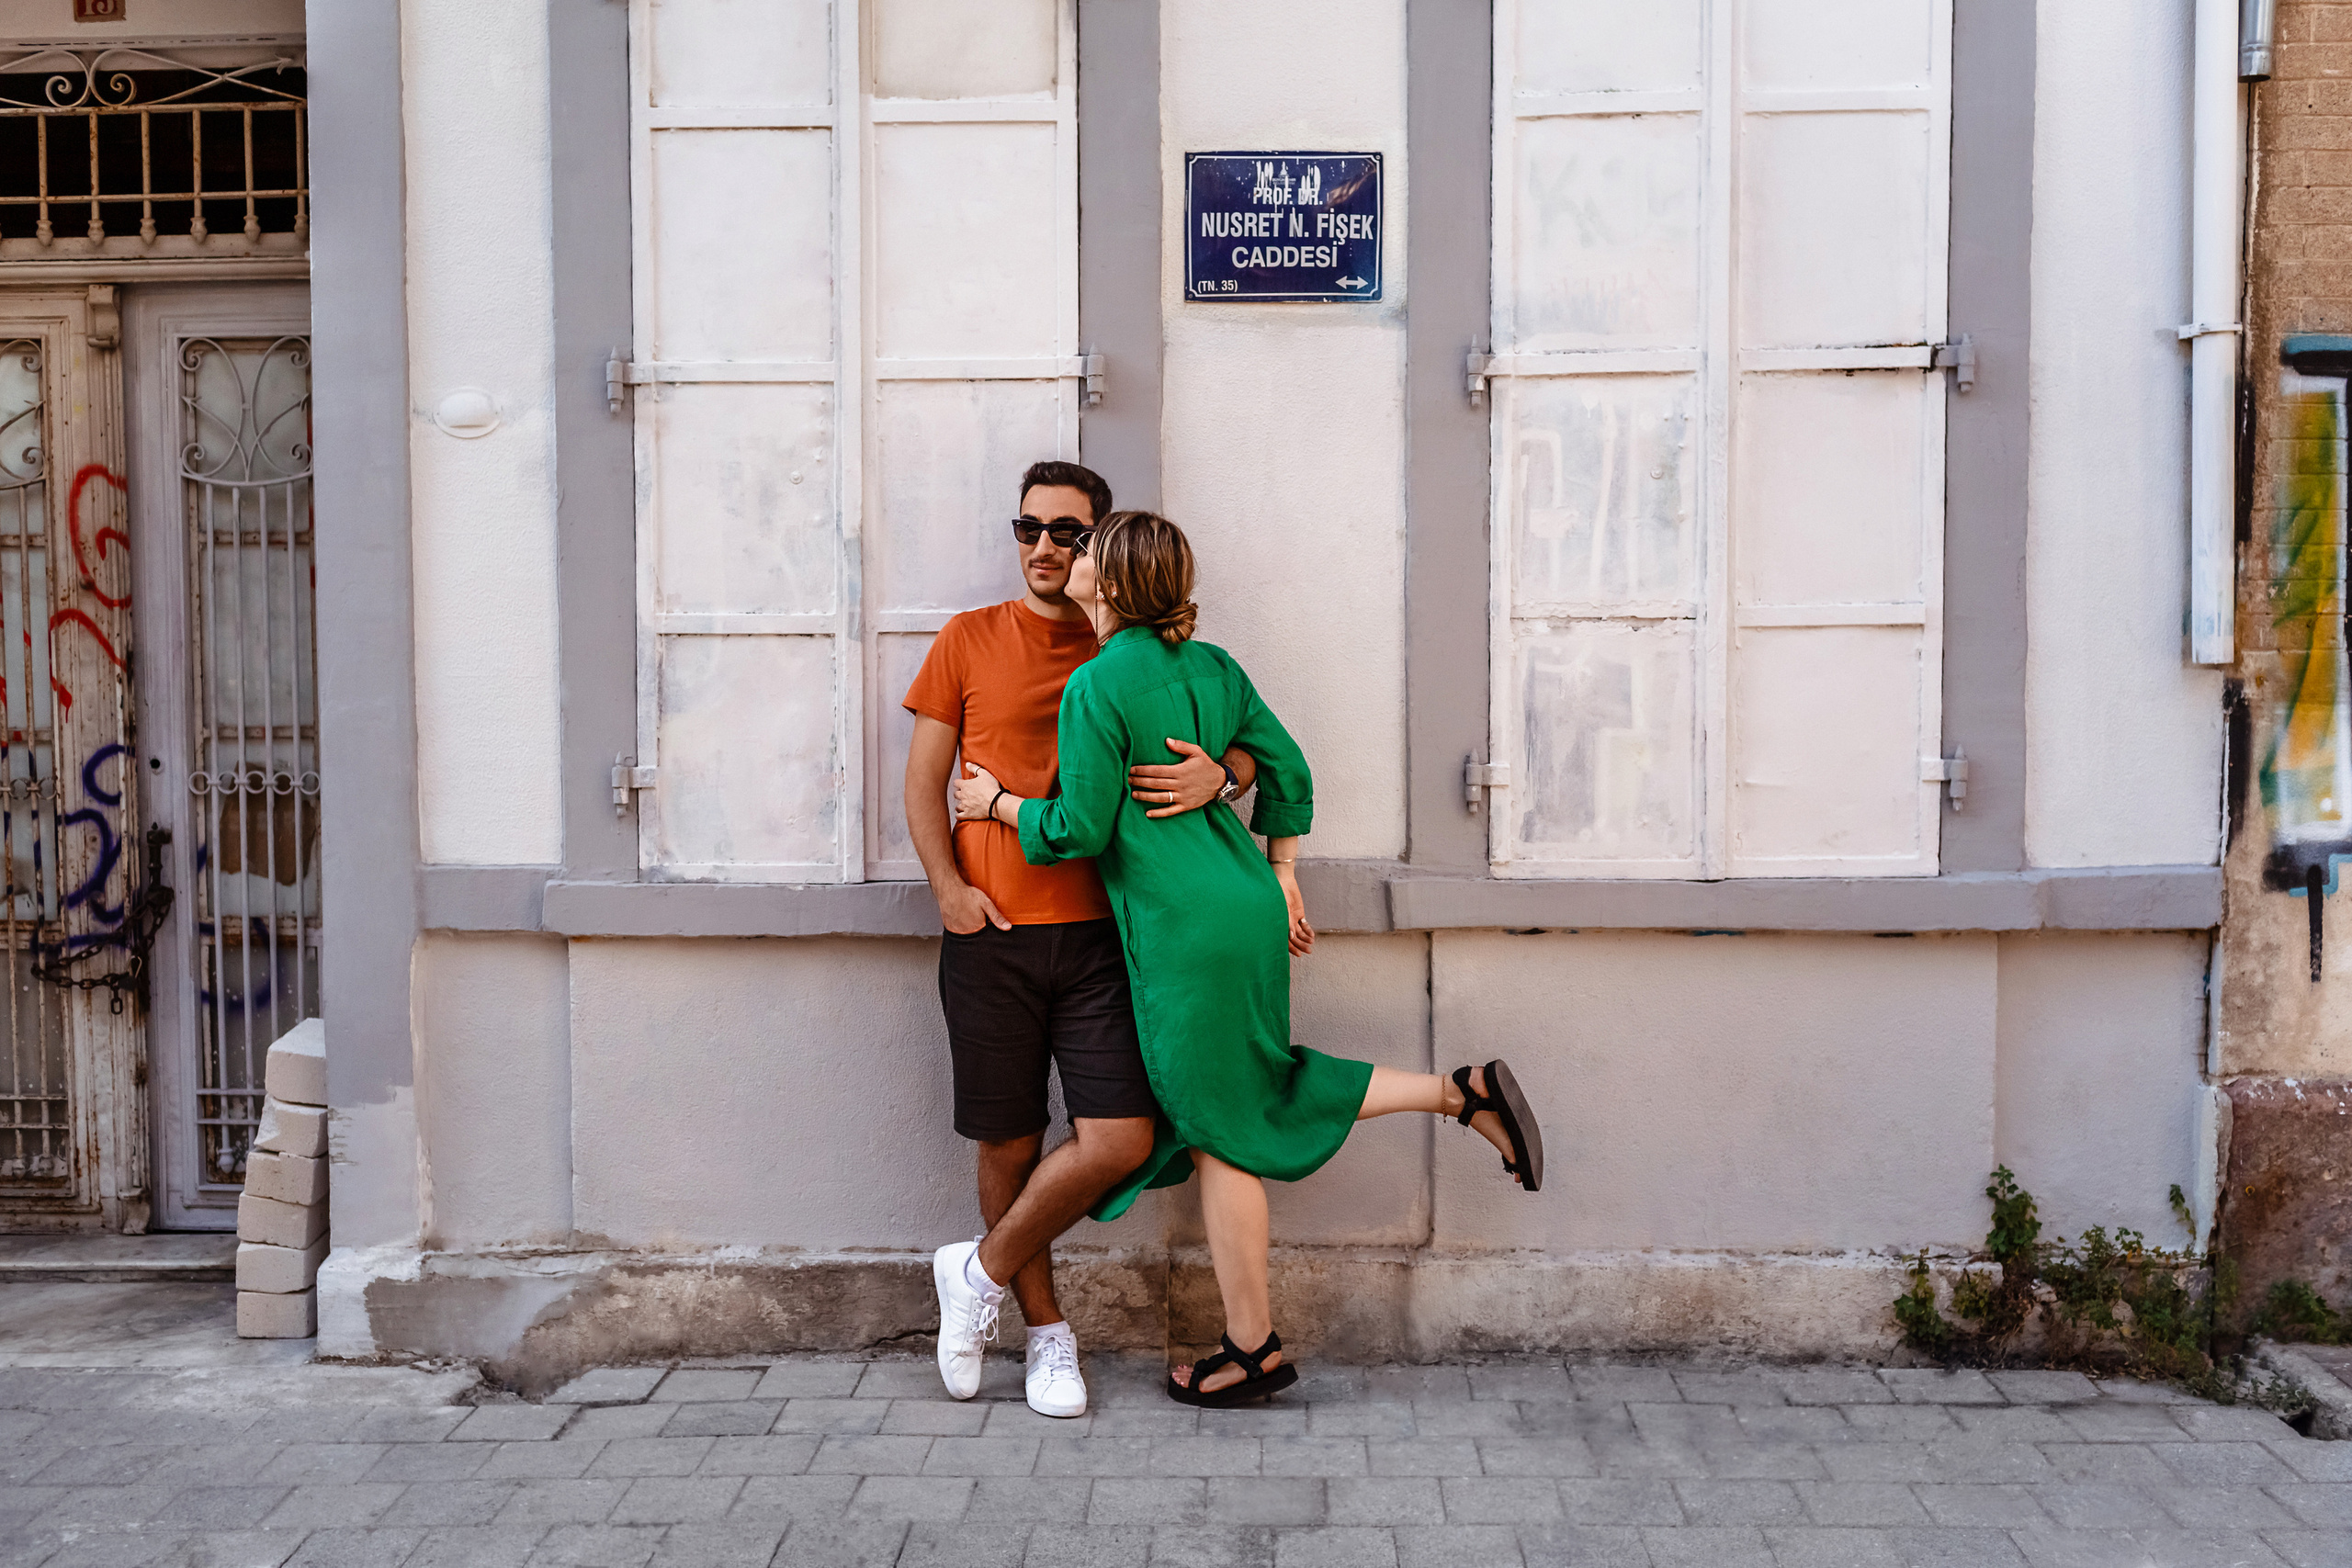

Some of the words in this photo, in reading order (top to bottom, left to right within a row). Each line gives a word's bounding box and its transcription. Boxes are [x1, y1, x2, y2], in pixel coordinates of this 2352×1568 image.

[1252, 186, 1294, 205] PROF.
[1297, 187, 1323, 206] DR.
[1202, 212, 1283, 237] NUSRET
[1289, 212, 1309, 238] N.
[1317, 209, 1374, 244] FİŞEK
[1231, 241, 1338, 267] CADDESİ
[1197, 280, 1218, 293] (TN.
[1221, 279, 1238, 292] 35)
